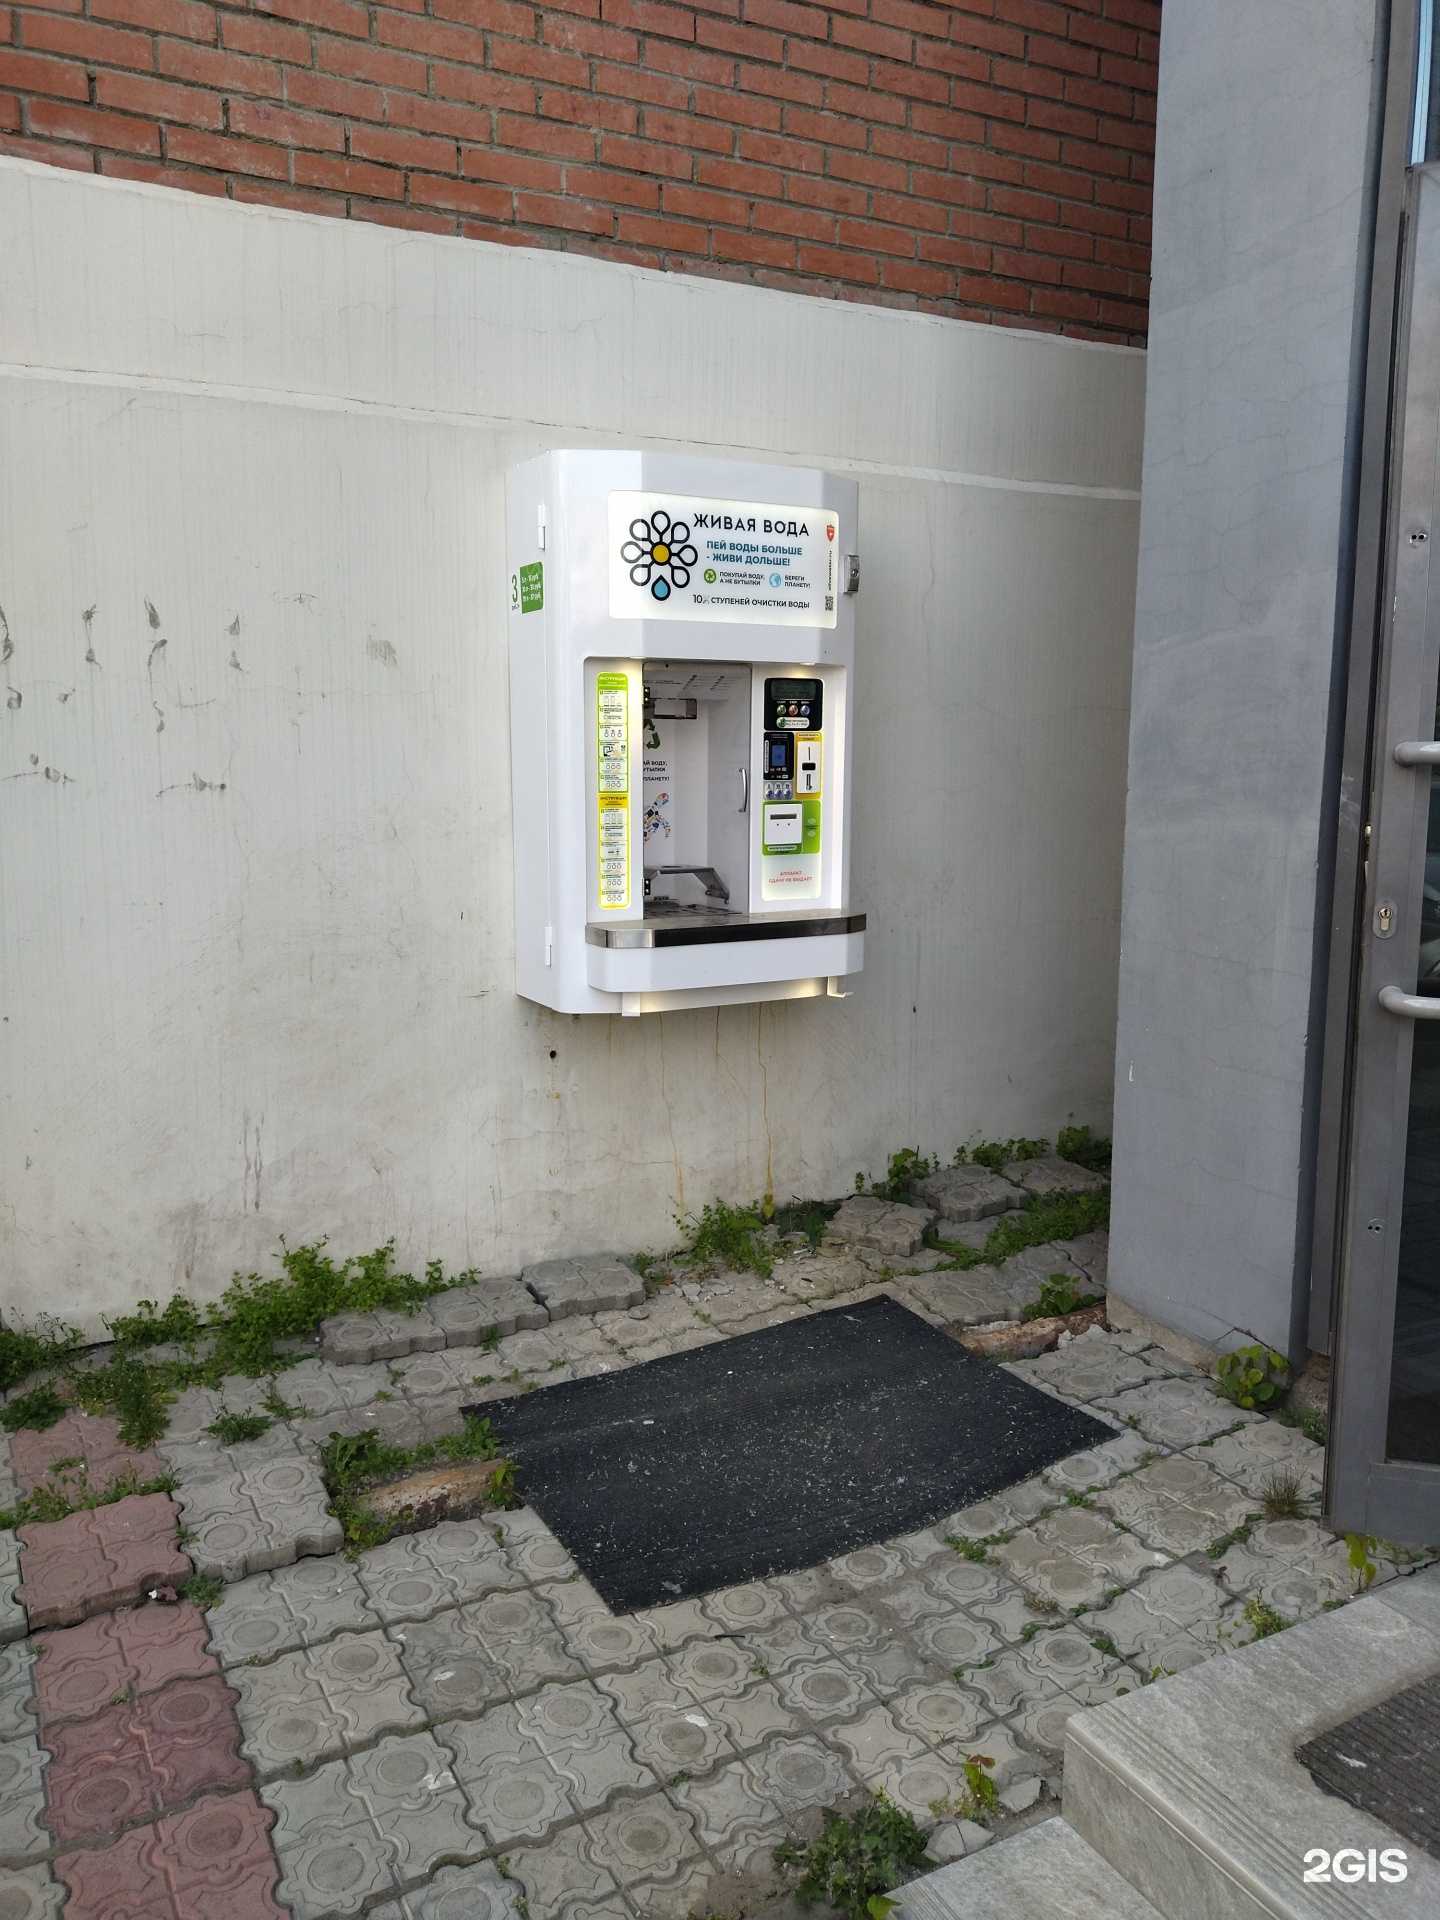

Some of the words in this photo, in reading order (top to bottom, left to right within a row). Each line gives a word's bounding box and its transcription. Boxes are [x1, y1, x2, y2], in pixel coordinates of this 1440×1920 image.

[693, 513, 756, 531] ЖИВАЯ
[763, 519, 810, 537] ВОДА
[706, 540, 727, 550] ПЕЙ
[729, 542, 759, 553] ВОДЫ
[761, 545, 803, 555] БОЛЬШЕ
[712, 553, 743, 563] ЖИВИ
[745, 556, 790, 566] ДОЛЬШЕ!
[711, 596, 750, 606] СТУПЕНЕЙ
[751, 599, 786, 608] ОЧИСТКИ
[788, 600, 810, 608] ВОДЫ
